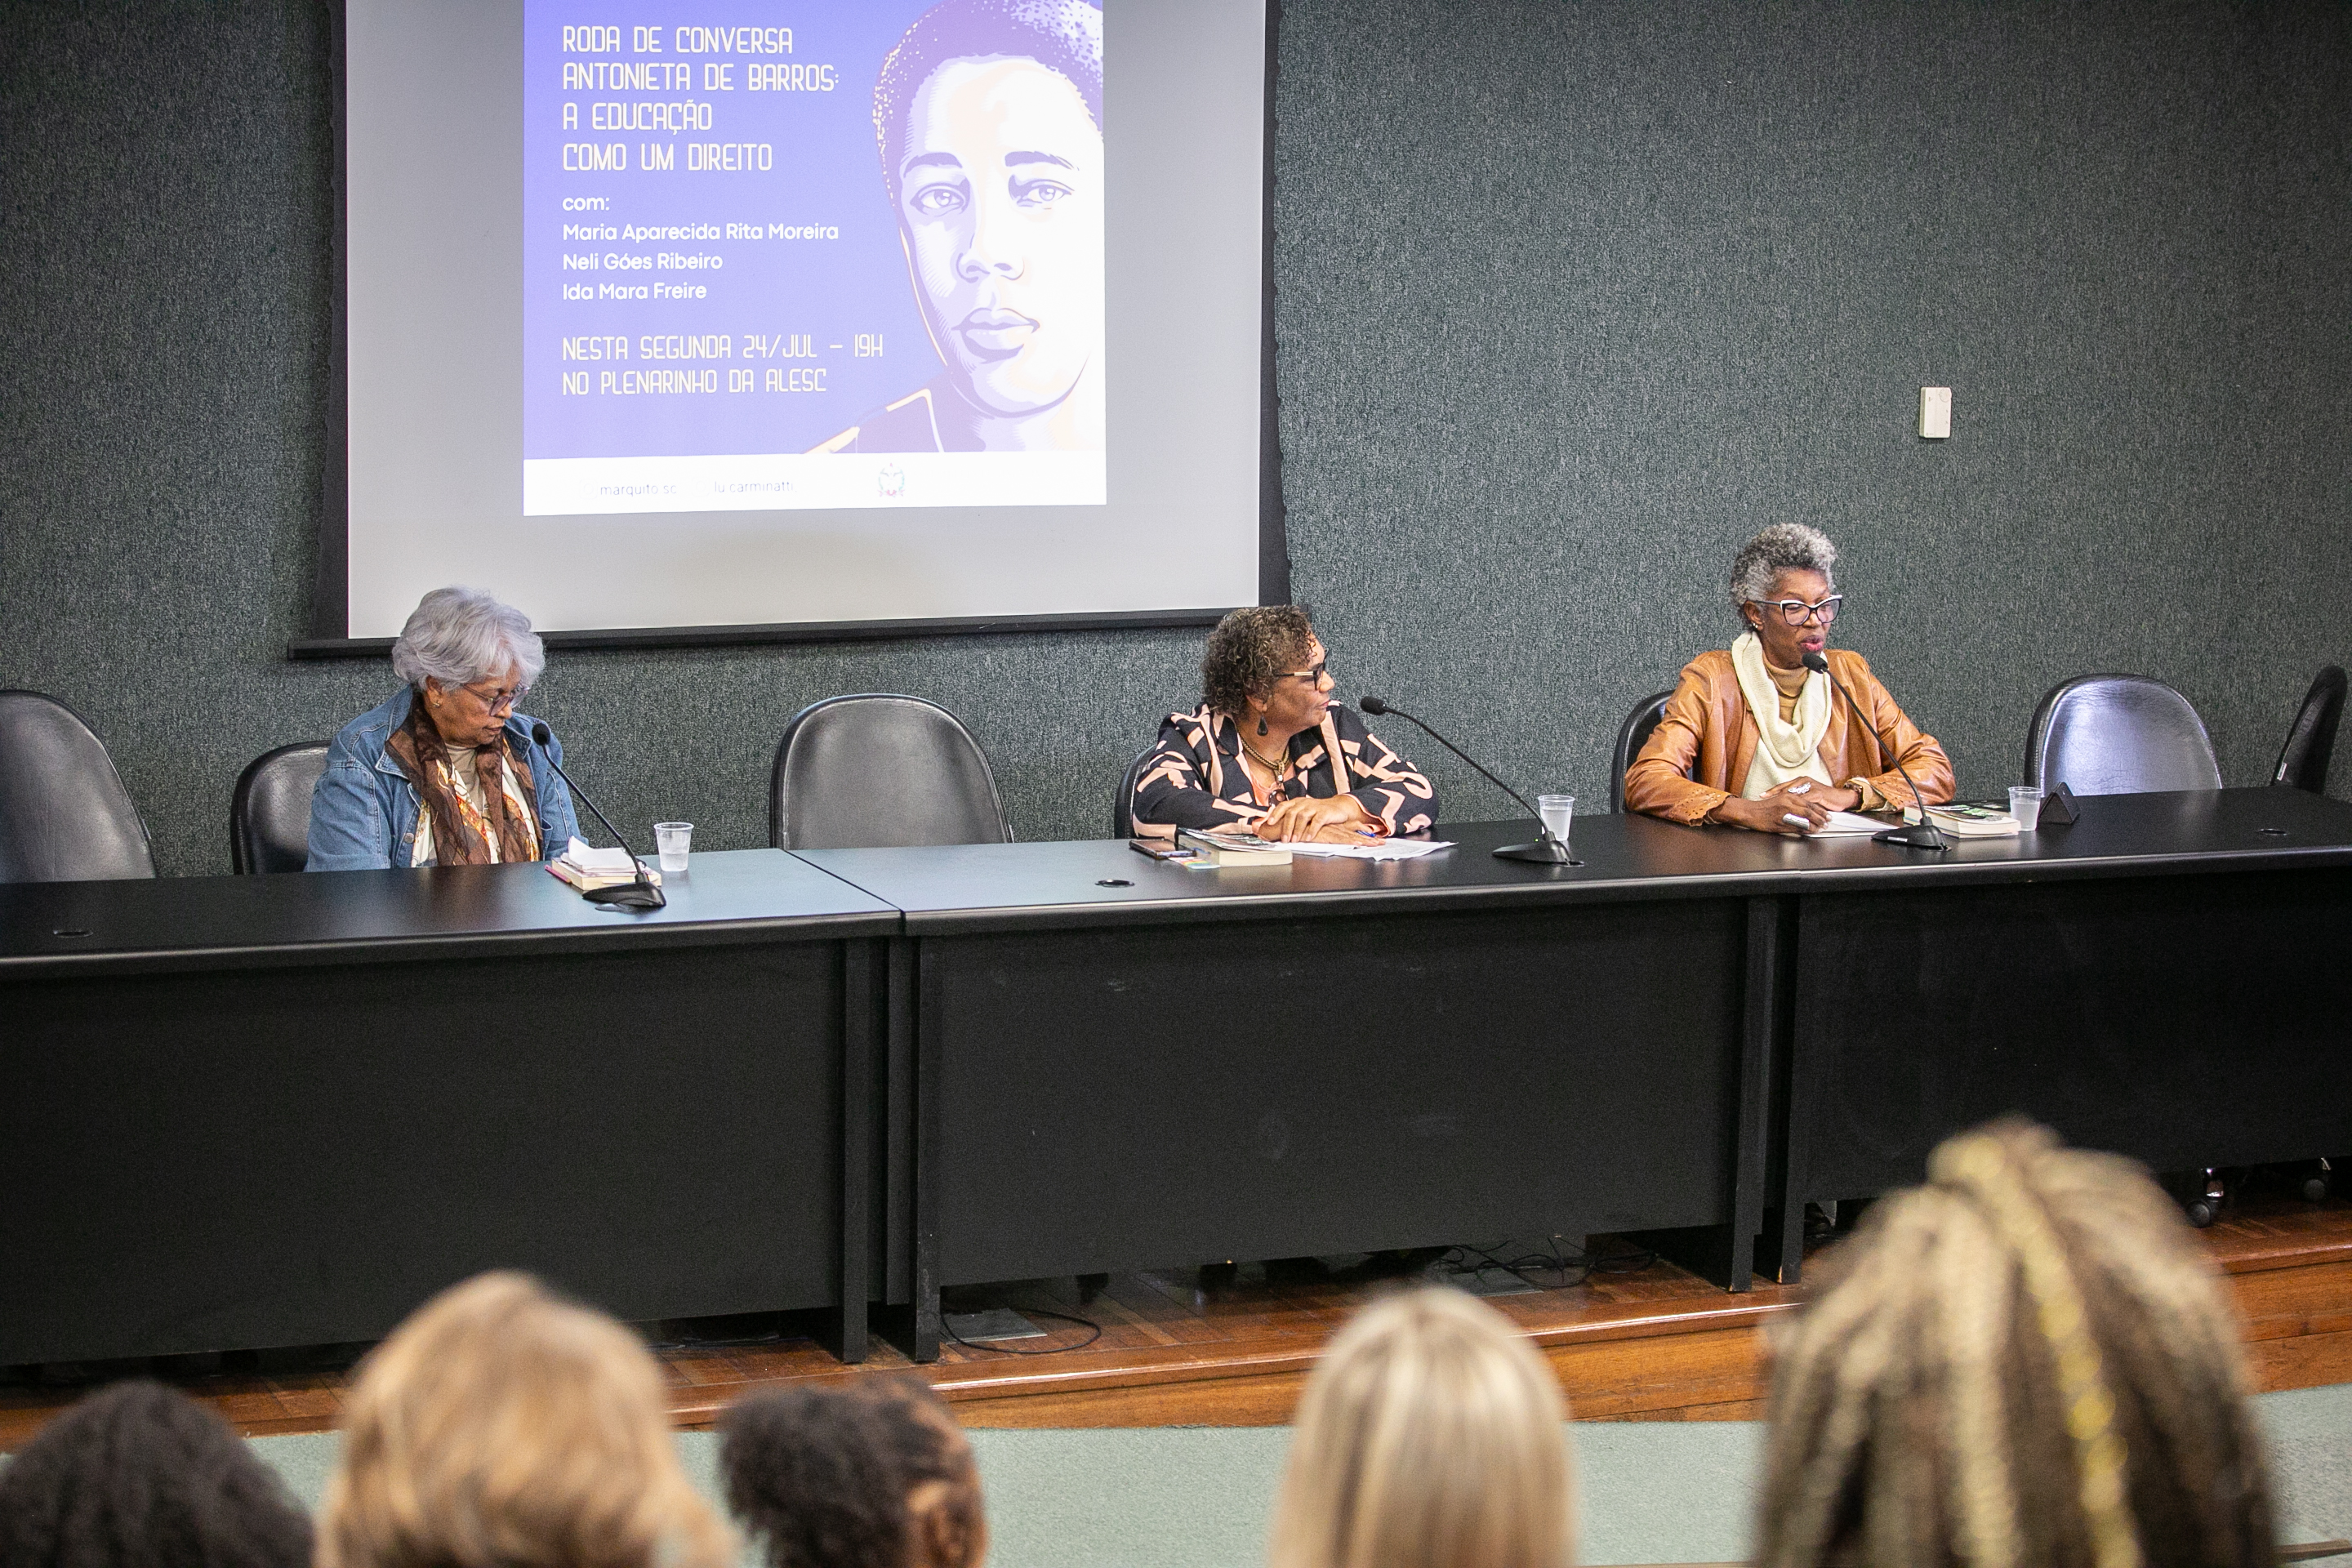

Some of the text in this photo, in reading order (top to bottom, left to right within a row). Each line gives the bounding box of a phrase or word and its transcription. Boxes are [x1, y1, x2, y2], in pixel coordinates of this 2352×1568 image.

[562, 24, 793, 54] RODA DE CONVERSA
[562, 61, 839, 91] ANTONIETA DE BARROS:
[562, 98, 712, 136] A EDUCAÇÃO
[562, 142, 773, 172] COMO UM DIREITO
[561, 196, 610, 212] com:
[562, 221, 839, 244] Maria Aparecida Rita Moreira
[562, 251, 724, 270] Neli Góes Ribeiro
[562, 280, 707, 301] Ida Mara Freire
[562, 335, 628, 361] NESTA
[639, 333, 732, 359] SEGUNDA
[742, 333, 817, 359] 24/JUL
[853, 332, 884, 358] 19H
[562, 367, 826, 396] NO PLENARINHO DA ALESC
[600, 483, 678, 497] marquito sc
